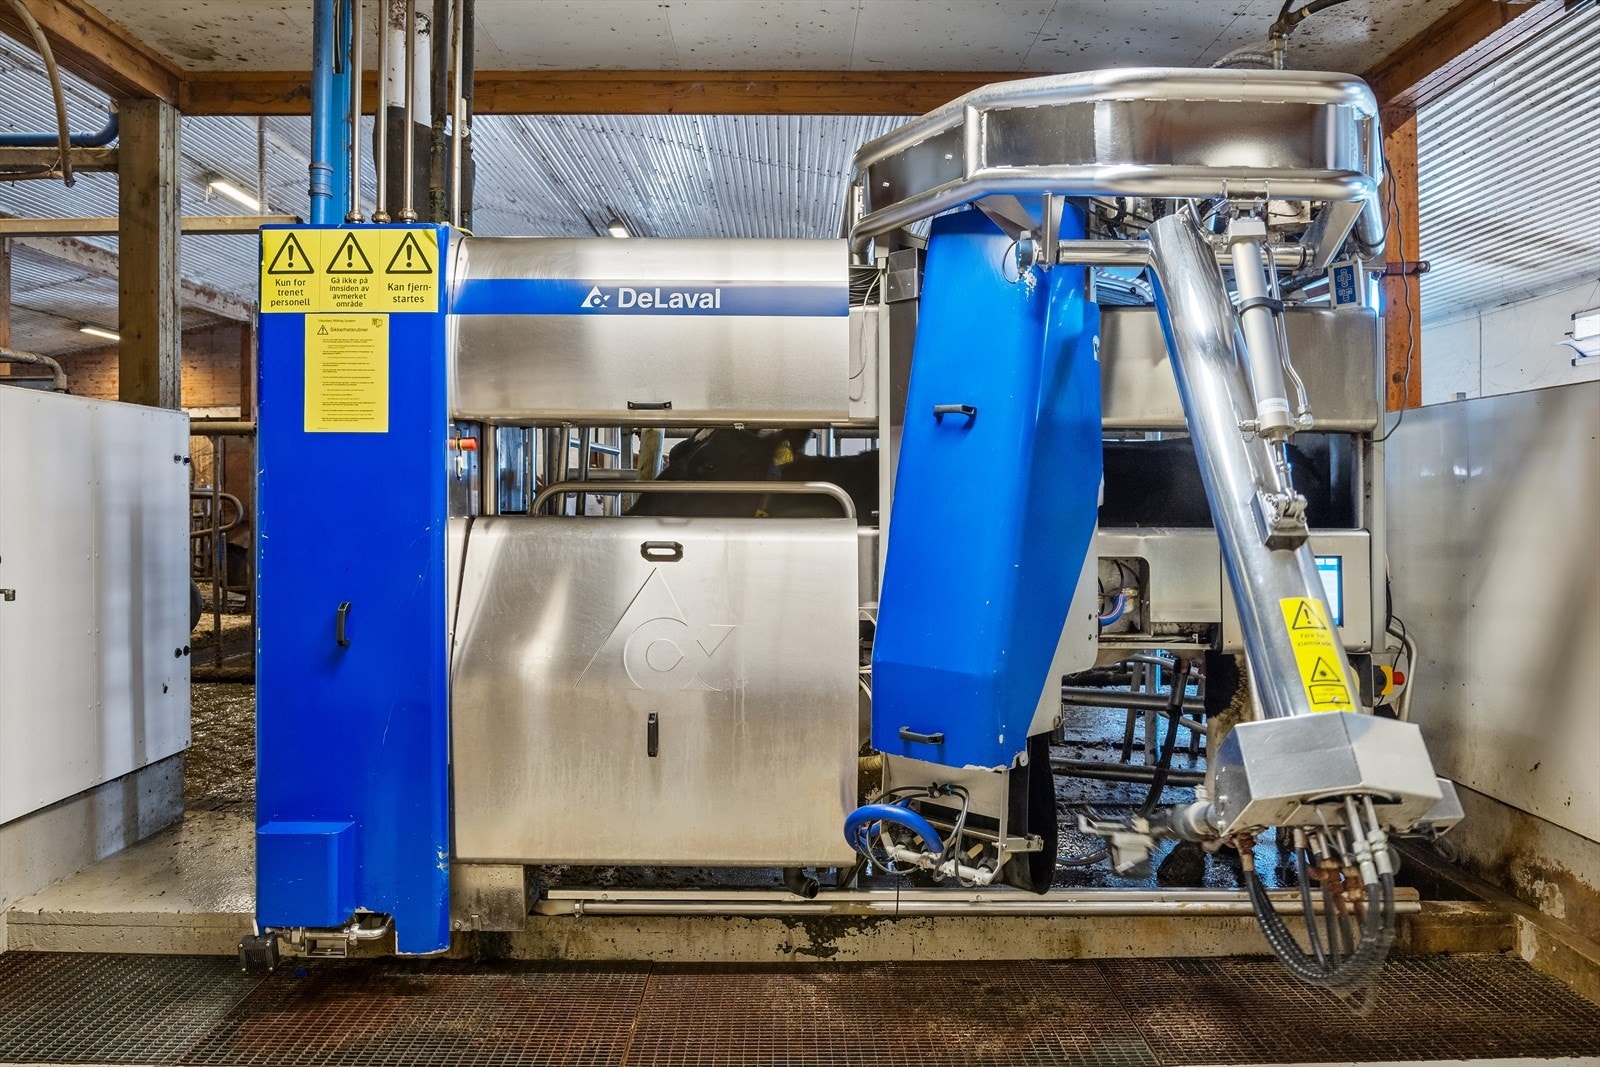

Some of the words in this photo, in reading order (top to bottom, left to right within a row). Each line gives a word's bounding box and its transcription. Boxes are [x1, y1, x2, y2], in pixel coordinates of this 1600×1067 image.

[294, 278, 306, 286] for
[359, 277, 368, 286] på
[387, 283, 404, 291] Kan
[407, 283, 432, 292] fjern-
[270, 298, 310, 307] personell
[392, 295, 424, 303] startes
[618, 288, 720, 308] DeLaval
